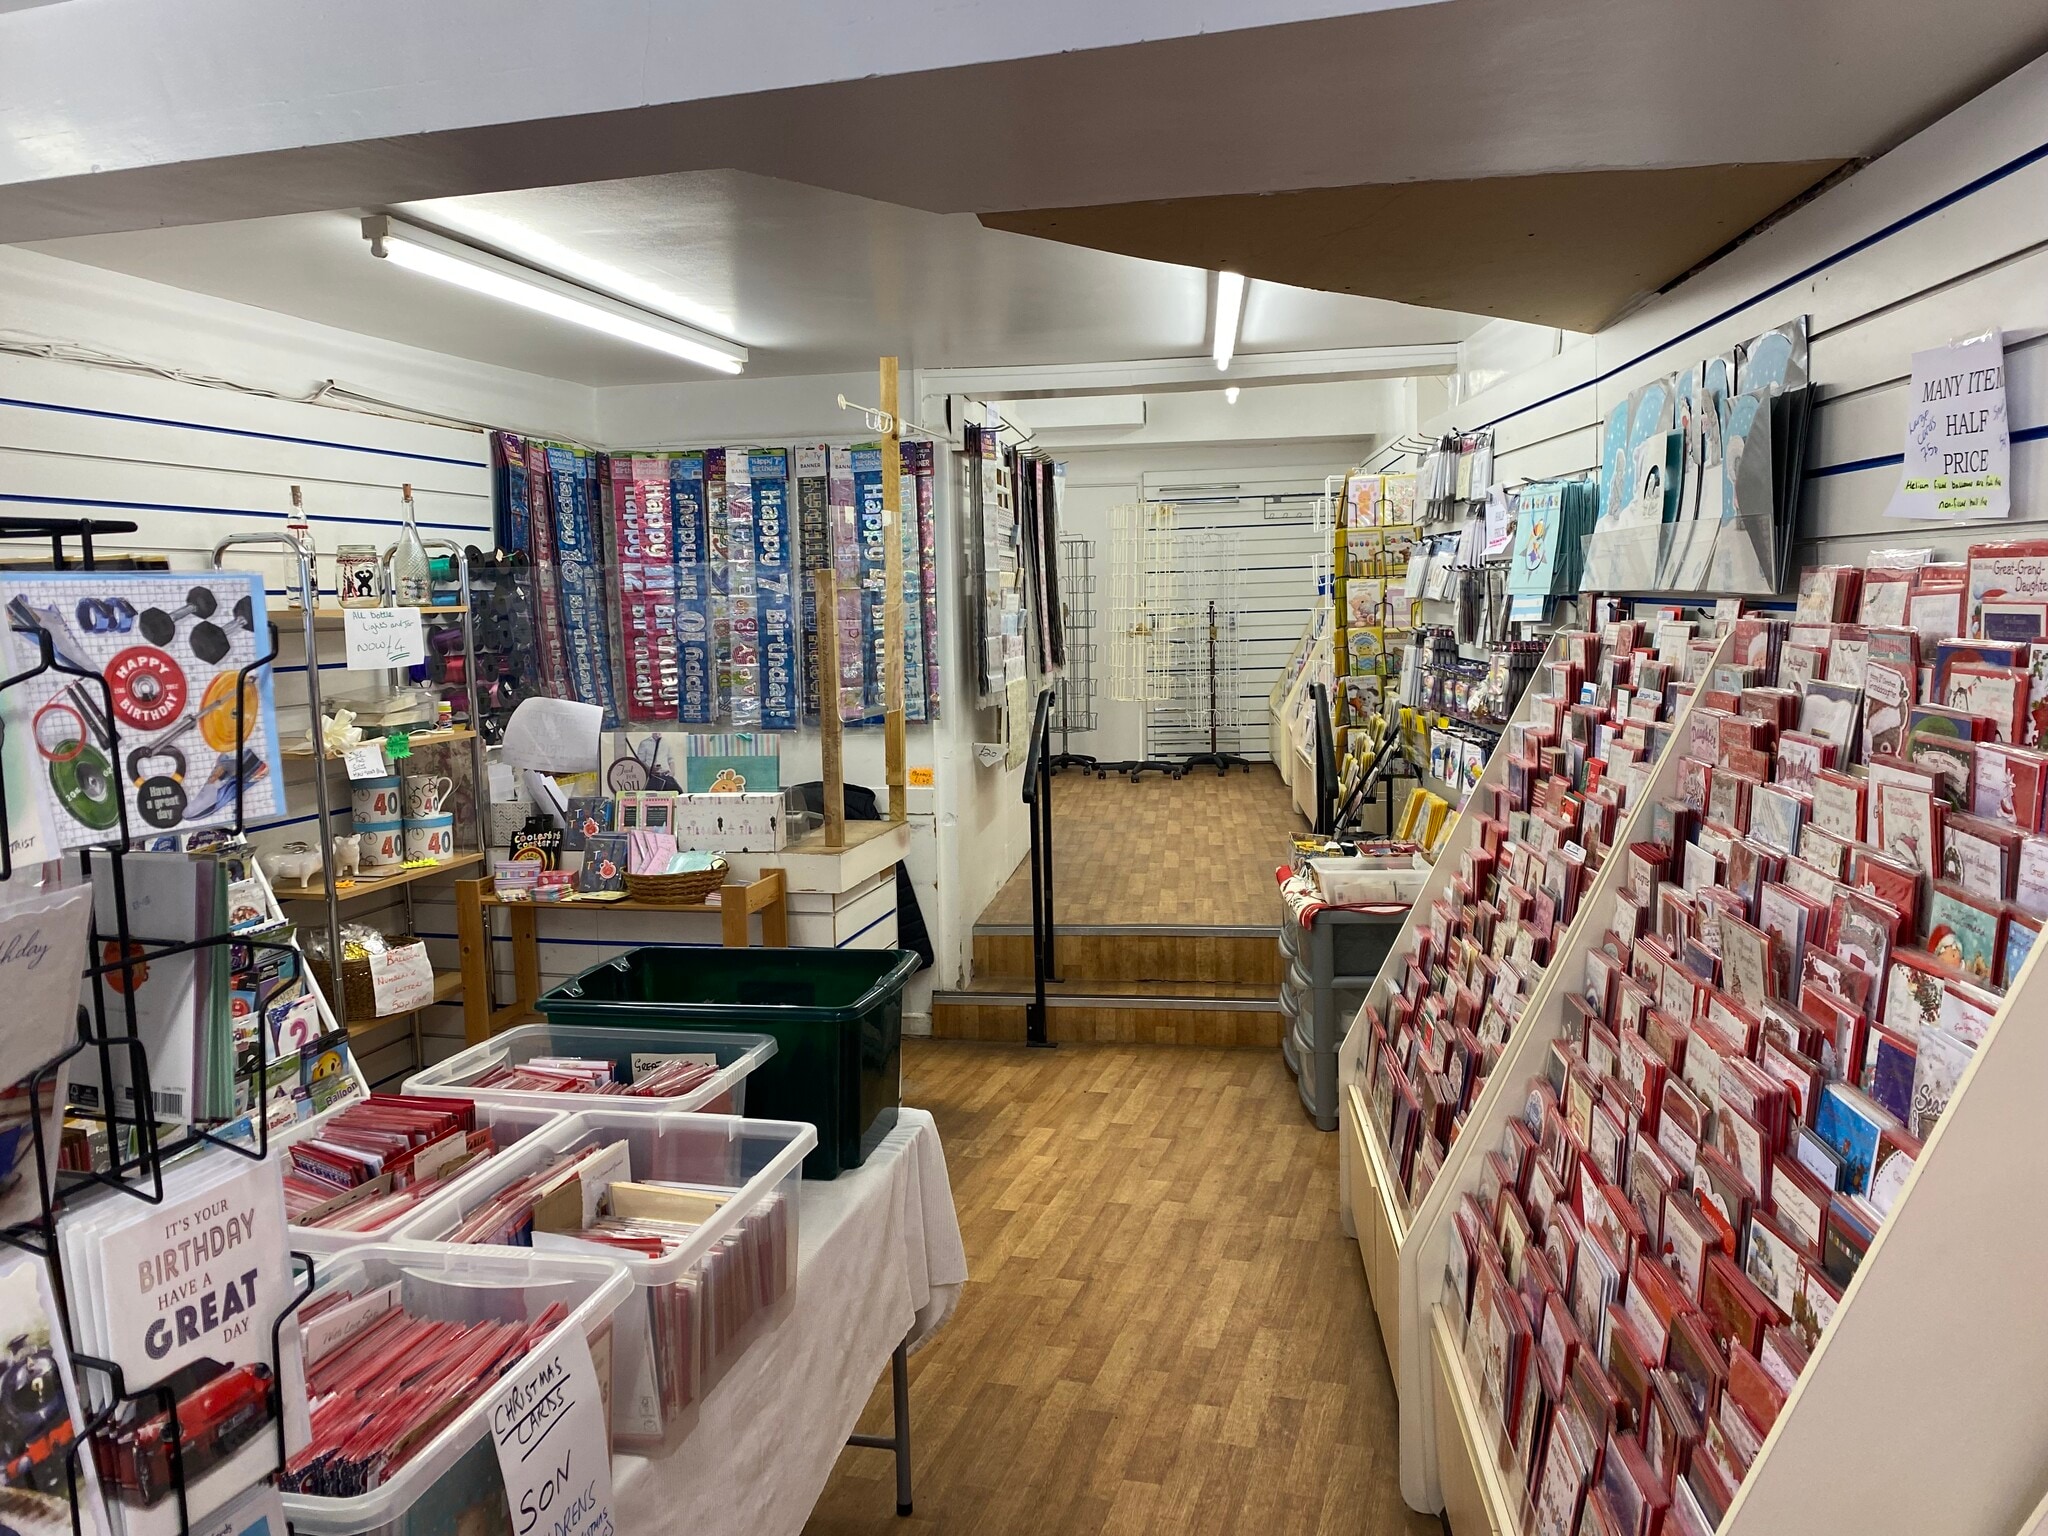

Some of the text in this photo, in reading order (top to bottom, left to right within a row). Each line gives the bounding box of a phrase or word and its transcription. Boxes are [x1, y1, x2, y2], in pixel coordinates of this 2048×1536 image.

[1922, 374, 1964, 403] MANY
[1946, 409, 1989, 437] HALF
[1943, 449, 1989, 475] PRICE
[558, 469, 576, 546] Happy
[760, 489, 780, 567] Happy
[862, 483, 885, 564] Happy
[680, 493, 698, 600] Birthday!
[1993, 559, 2046, 576] Great-Grand-
[643, 483, 667, 558] Happy
[655, 603, 678, 707] Birthday!
[2015, 576, 2048, 596] Daughte
[357, 641, 385, 652] NOW
[116, 656, 170, 679] HAPPY
[765, 607, 790, 718] Birthday!
[685, 647, 703, 719] Happy
[119, 692, 178, 721] BIRTHDAY
[617, 764, 634, 777] Just
[150, 786, 172, 798] Have
[617, 780, 640, 791] YOU
[146, 795, 180, 811] a great
[156, 808, 174, 820] day
[373, 792, 398, 816] 40
[424, 797, 438, 812] 40
[381, 834, 402, 858] 40
[427, 831, 451, 855] 40
[0, 929, 48, 970] hday
[326, 1081, 358, 1107] Balloon
[165, 1200, 229, 1240] IT'S YOUR
[138, 1208, 256, 1295] BIRTHDAY
[158, 1273, 212, 1312] HAVE A
[145, 1268, 259, 1361] GREAT
[224, 1317, 250, 1345] DAY
[494, 1356, 563, 1436] CHRISTMAS
[520, 1449, 571, 1535] SON
[547, 1480, 596, 1536] DRENS
